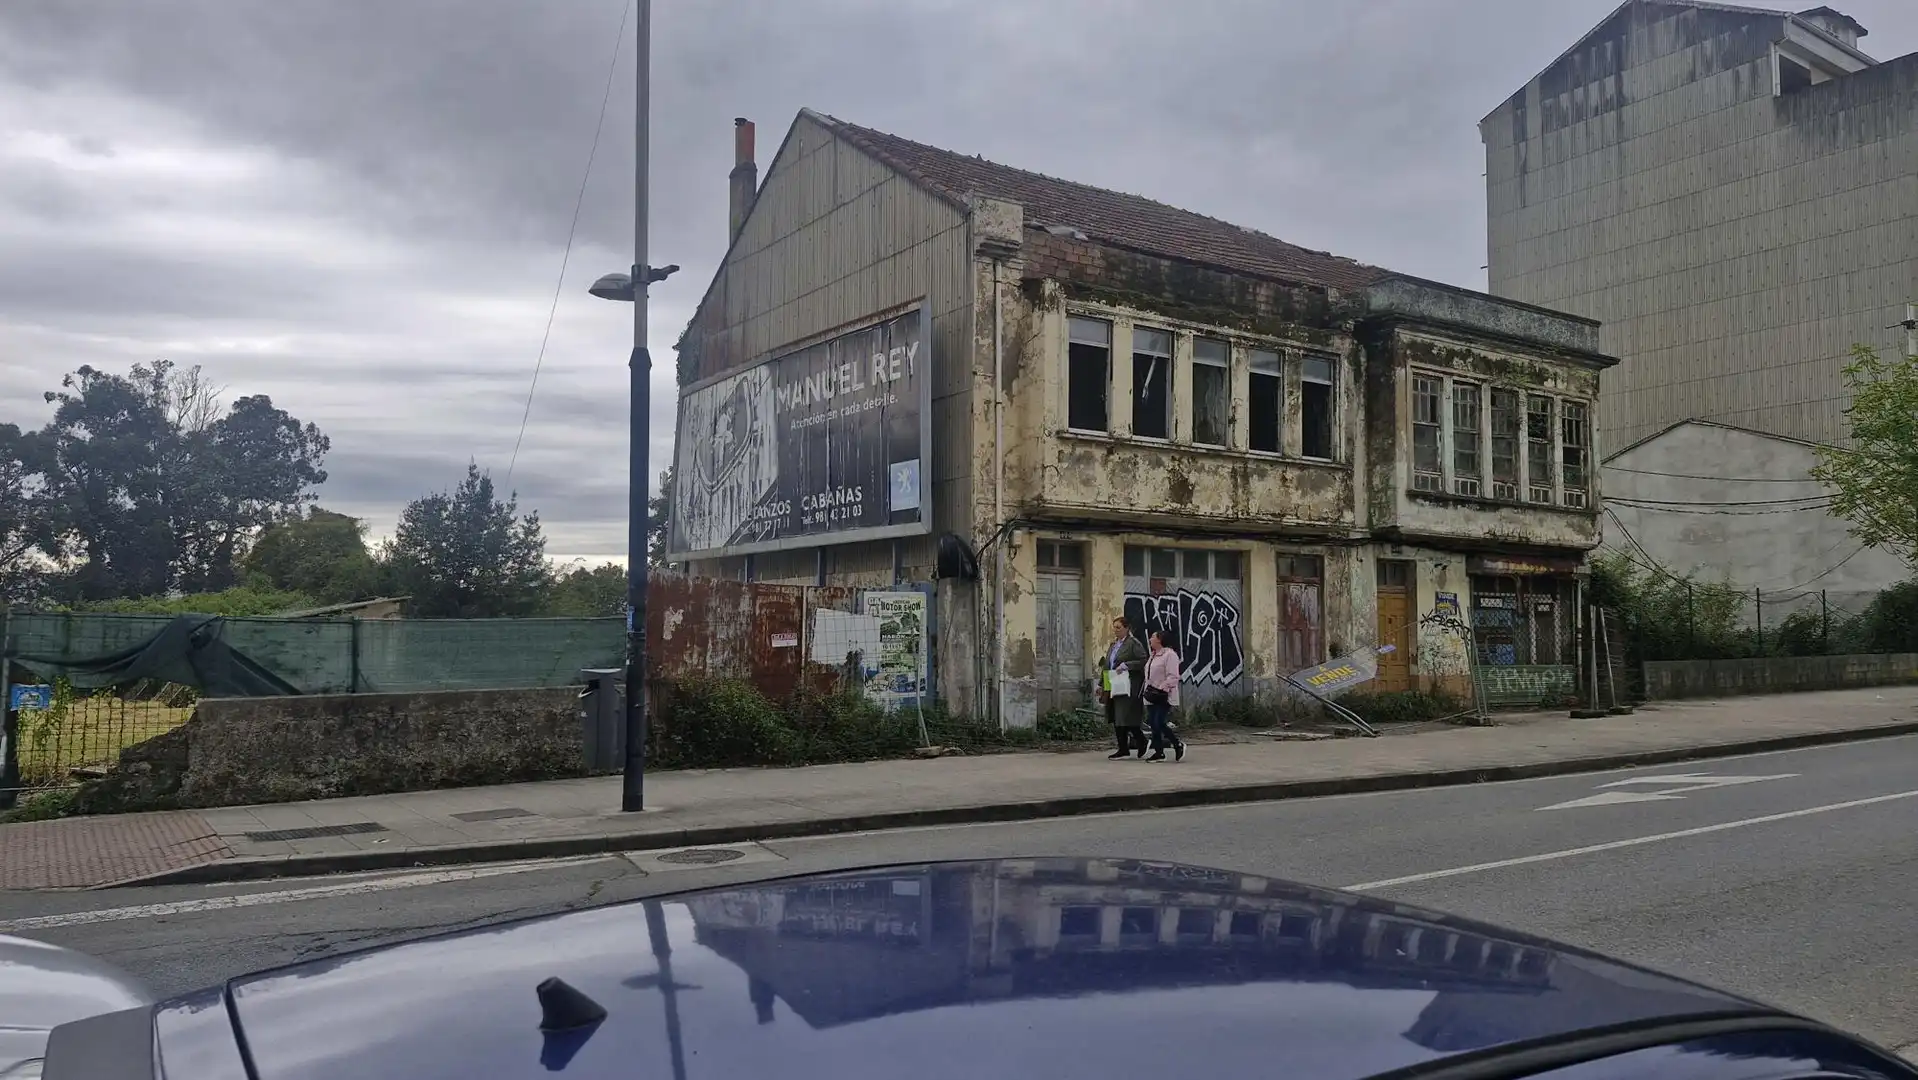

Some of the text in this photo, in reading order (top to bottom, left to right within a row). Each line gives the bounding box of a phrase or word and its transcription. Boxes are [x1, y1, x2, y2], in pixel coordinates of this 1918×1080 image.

[776, 341, 919, 415] MANUEL REY
[790, 411, 826, 431] Atención
[827, 408, 838, 421] en
[840, 401, 861, 416] cada
[801, 485, 862, 511] CABAÑAS
[841, 506, 850, 519] 21
[853, 504, 862, 517] 03
[881, 601, 902, 611] MOTOR
[903, 600, 921, 611] SHOW
[1306, 664, 1358, 685] VENDE
